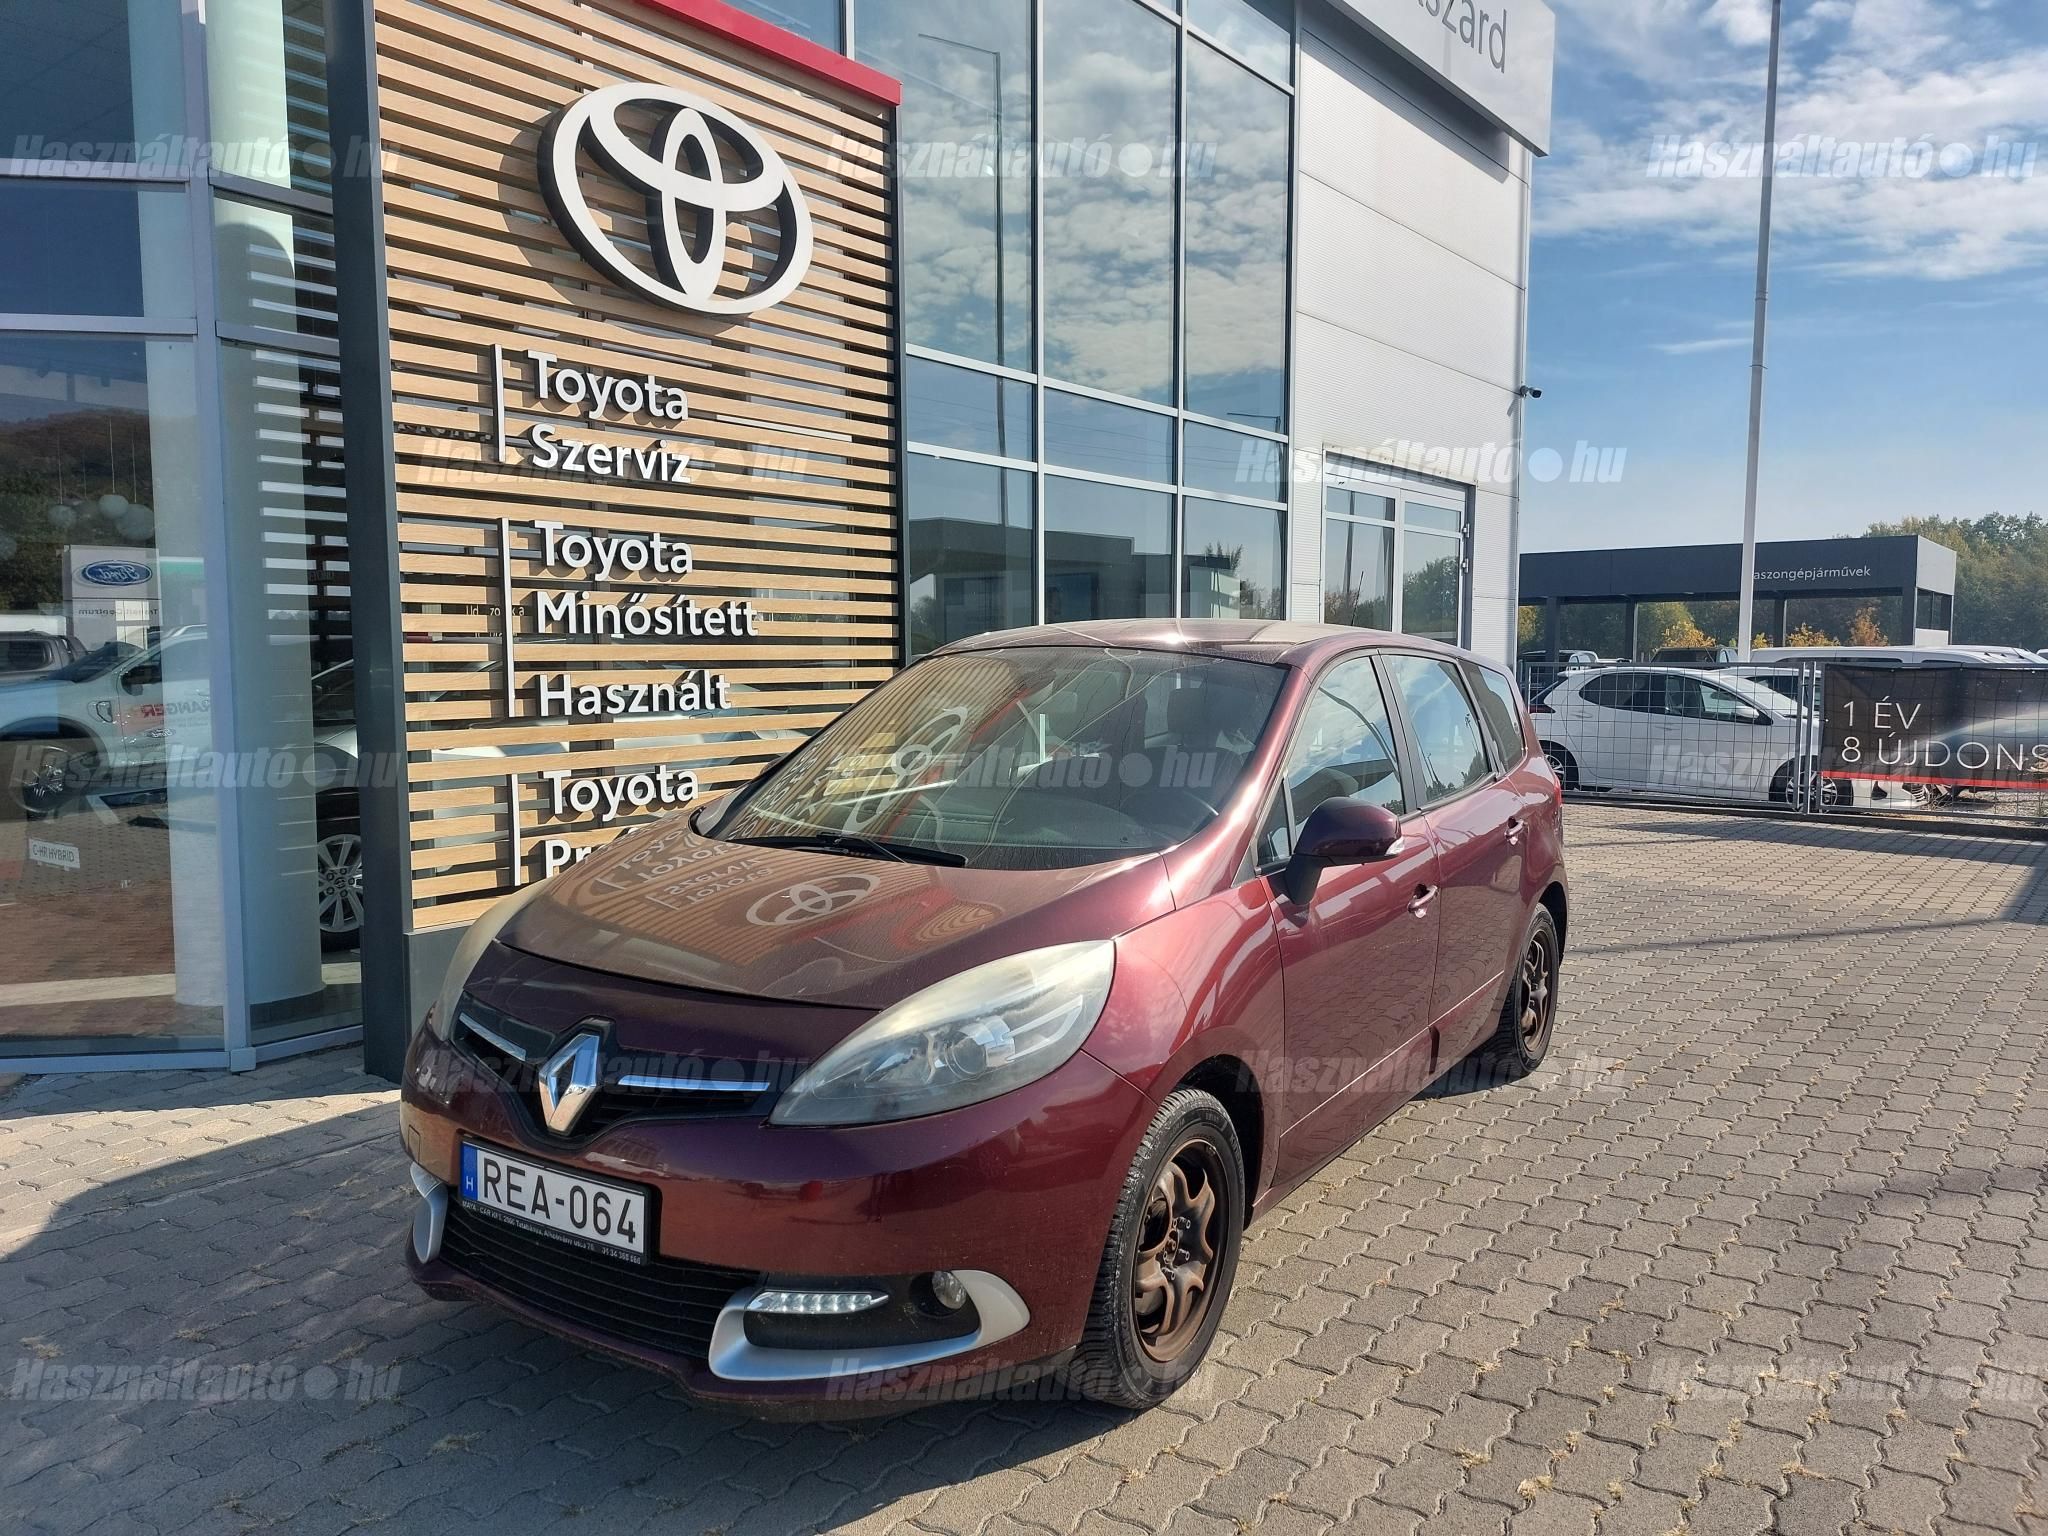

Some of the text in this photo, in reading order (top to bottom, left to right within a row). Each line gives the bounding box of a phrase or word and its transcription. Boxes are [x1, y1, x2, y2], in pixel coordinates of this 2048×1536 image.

[528, 350, 688, 421] Toyota
[531, 423, 691, 483] Szerviz
[534, 520, 693, 582] Toyota
[1753, 565, 1871, 581] aszongépjárművek
[536, 591, 759, 636] Minősített
[539, 669, 731, 717] Használt
[1843, 695, 1921, 730] 1 ÉV
[1841, 736, 1861, 763] 8
[543, 764, 698, 822] Toyota
[465, 1175, 475, 1192] H
[483, 1157, 636, 1244] REA-064
